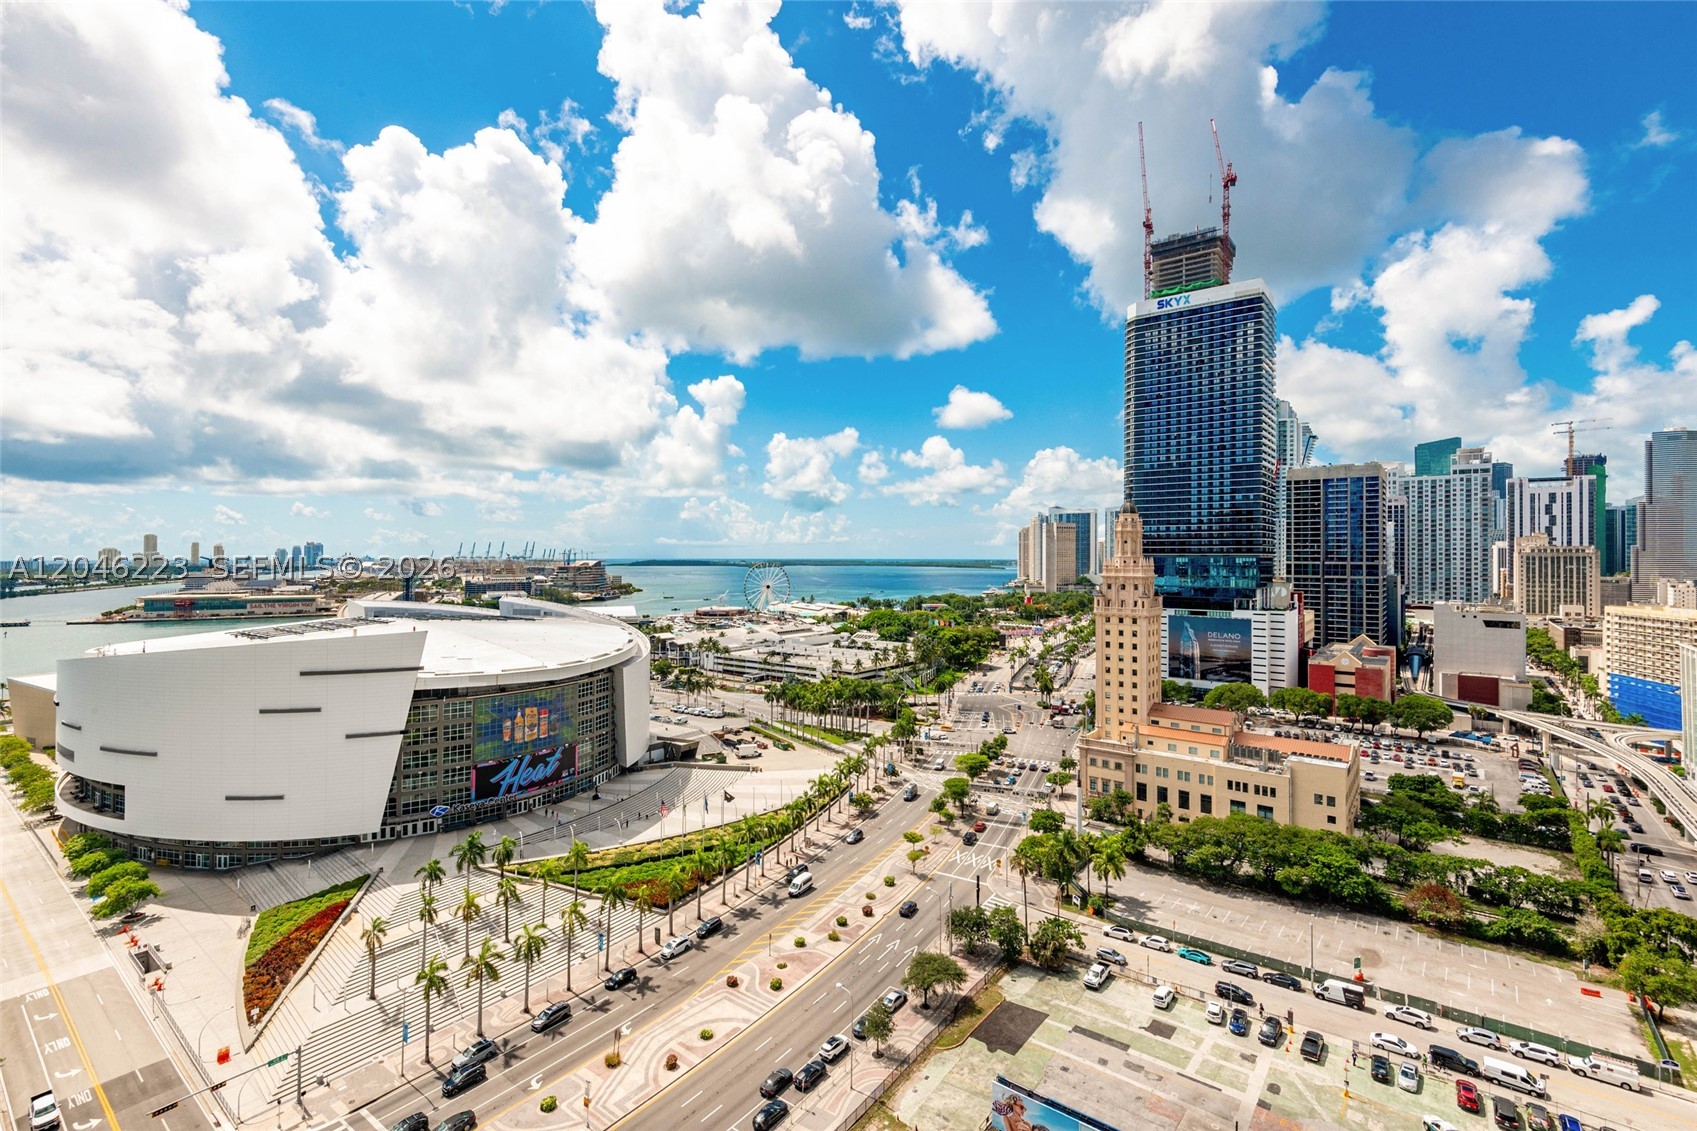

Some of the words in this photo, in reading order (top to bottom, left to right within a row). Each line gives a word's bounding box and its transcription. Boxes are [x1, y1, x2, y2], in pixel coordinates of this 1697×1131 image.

[1157, 294, 1191, 309] SKYX
[1208, 631, 1241, 639] DELANO
[490, 746, 564, 798] Heat
[452, 800, 485, 814] Kaseya
[486, 793, 517, 806] Center
[25, 988, 50, 1003] ONLY
[44, 1036, 71, 1055] ONLY
[67, 1089, 93, 1110] ONLY
